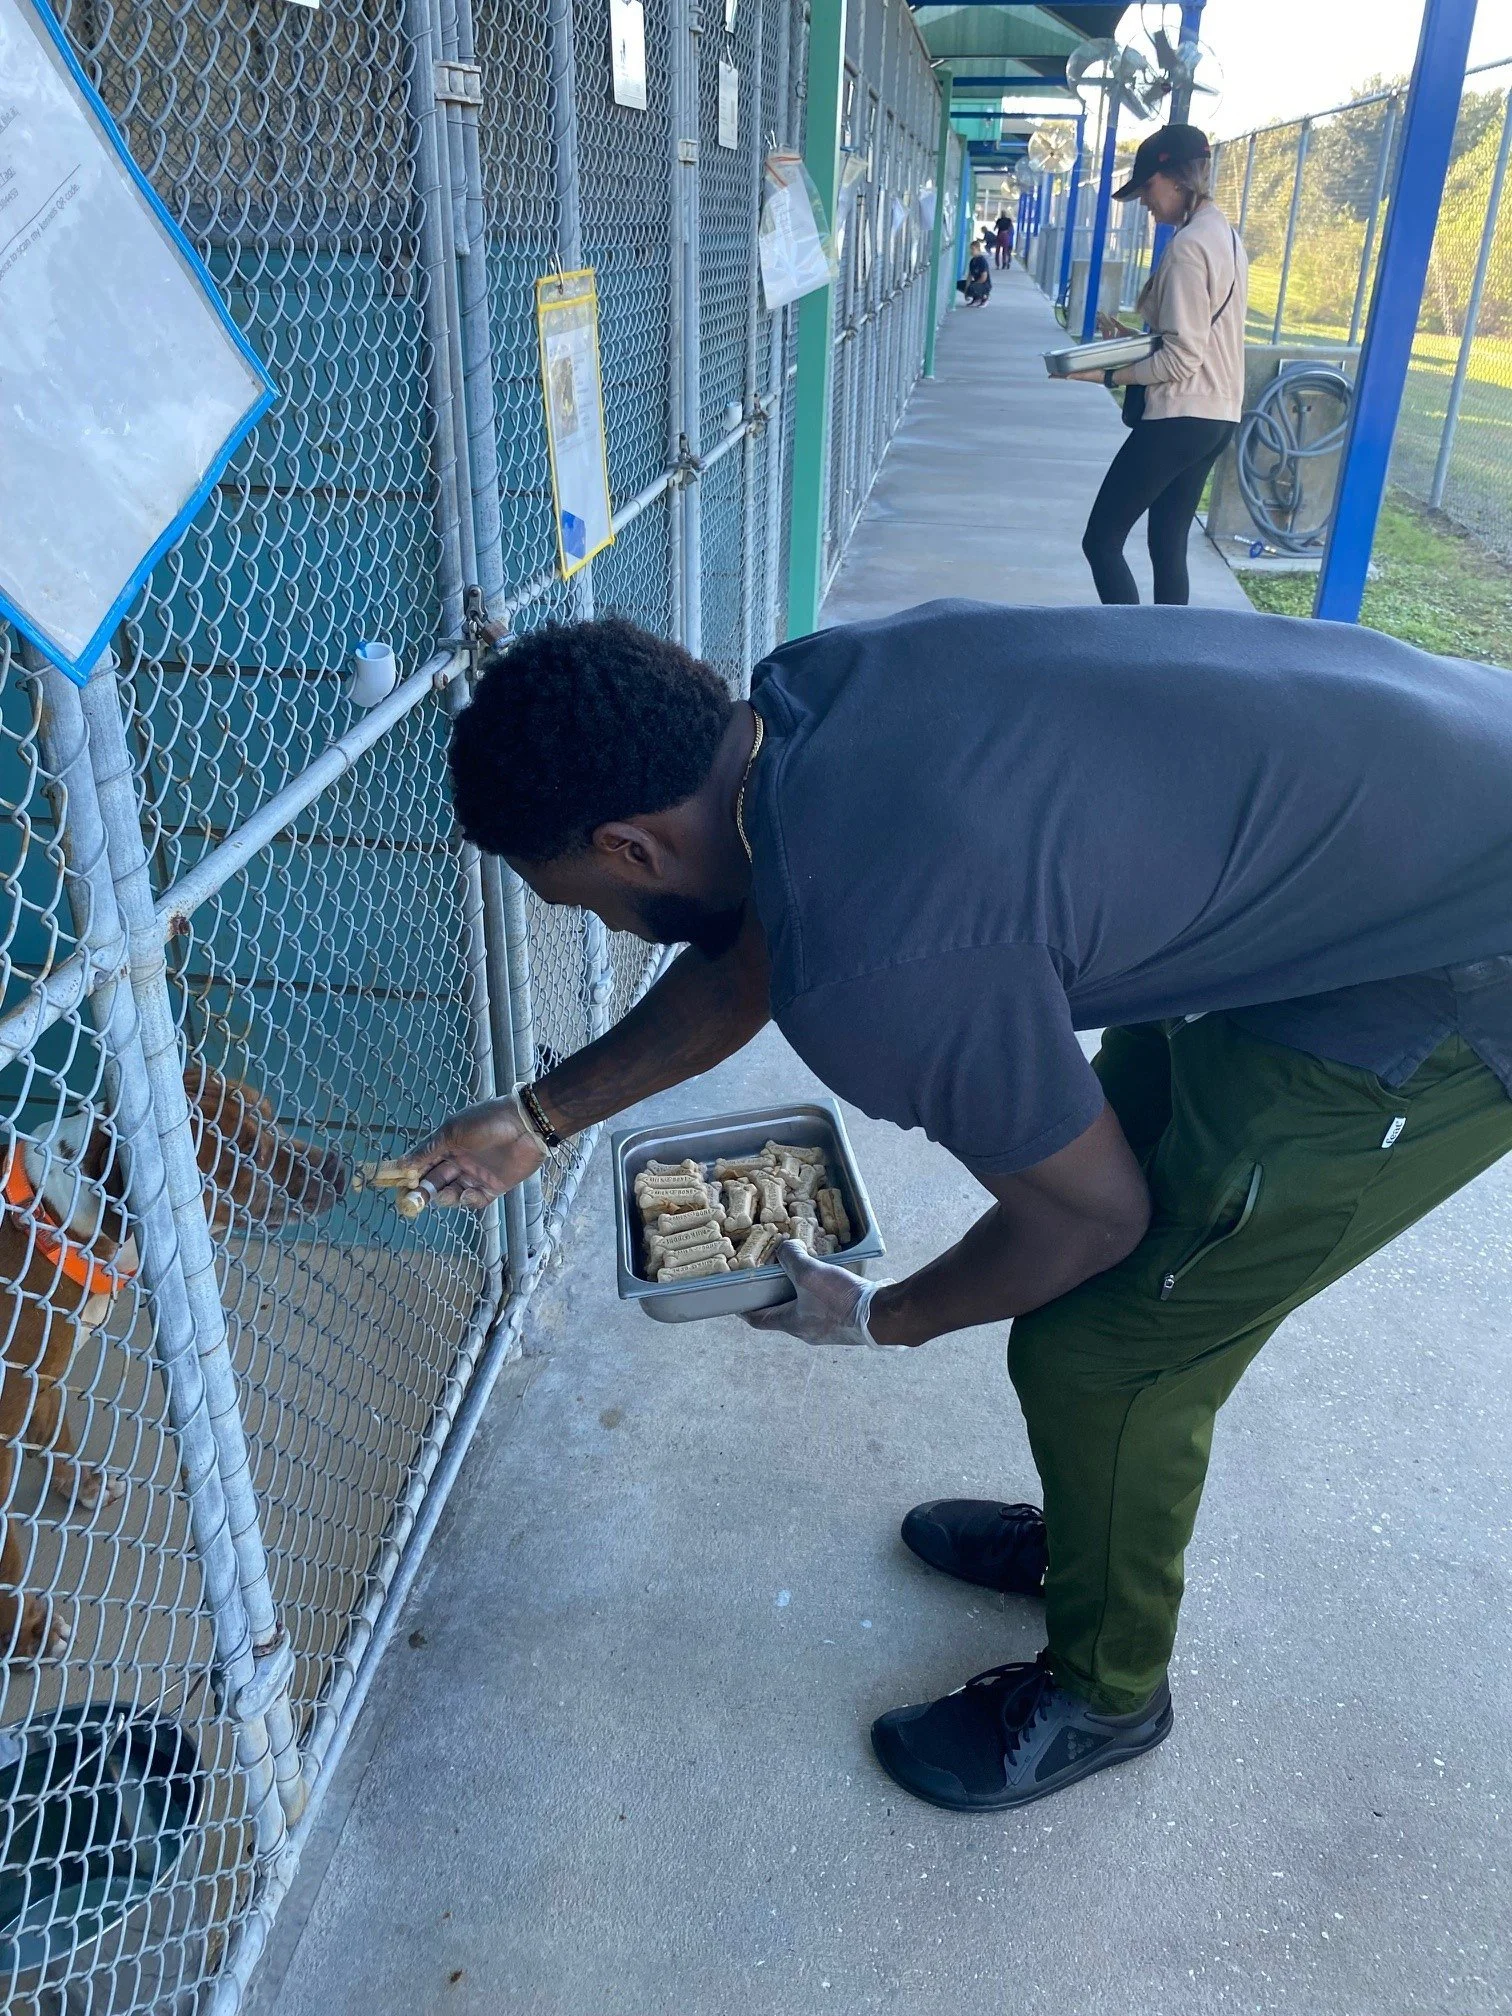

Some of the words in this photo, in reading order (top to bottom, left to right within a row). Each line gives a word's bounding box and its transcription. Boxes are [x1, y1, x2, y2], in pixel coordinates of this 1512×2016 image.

[9, 252, 18, 263] to
[17, 238, 31, 255] scan
[30, 228, 41, 242] my
[56, 196, 66, 209] QR
